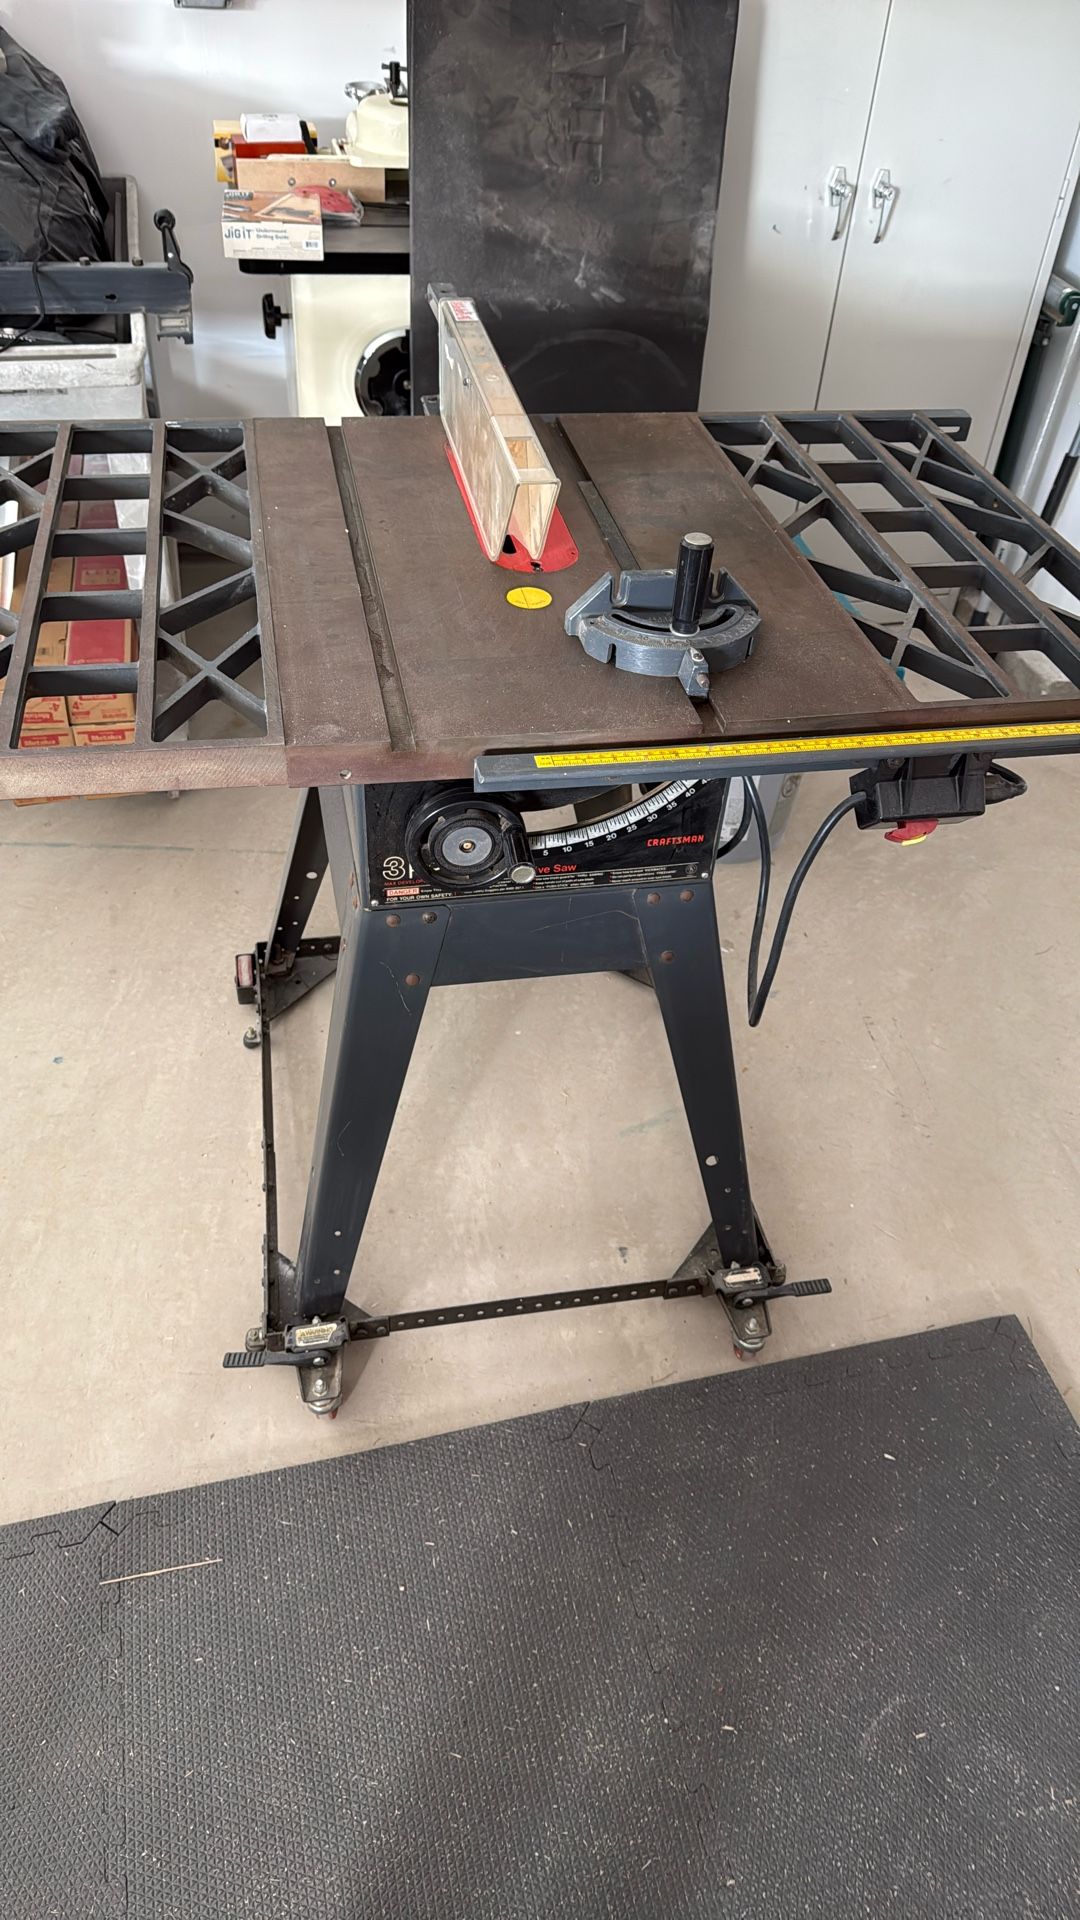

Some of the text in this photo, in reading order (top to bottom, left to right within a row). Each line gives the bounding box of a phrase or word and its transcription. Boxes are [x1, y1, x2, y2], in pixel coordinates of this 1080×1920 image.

[685, 788, 696, 798] 40
[666, 801, 678, 811] 35
[647, 813, 658, 823] 30
[626, 824, 638, 833] 25
[605, 832, 617, 841] 20
[646, 835, 705, 848] CRAFTSMAN
[553, 863, 577, 873] Saw
[389, 888, 418, 896] DANGER
